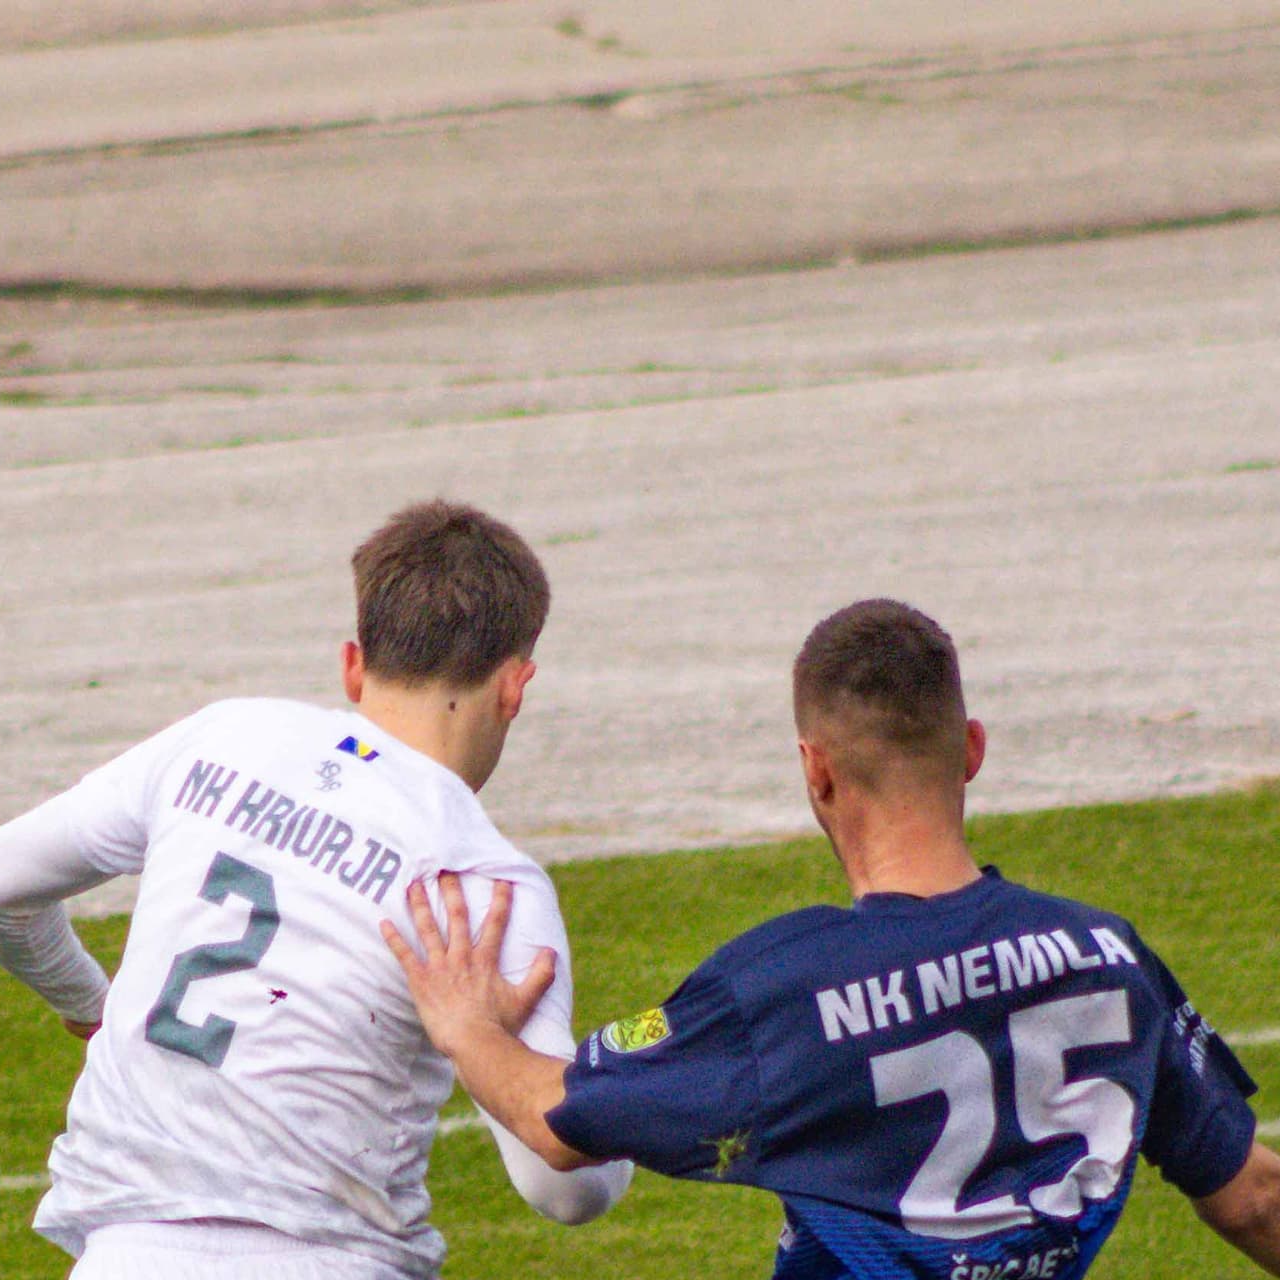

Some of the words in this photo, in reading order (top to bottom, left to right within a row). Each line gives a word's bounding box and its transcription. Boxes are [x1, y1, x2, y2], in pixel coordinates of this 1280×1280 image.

[173, 760, 239, 818] NK
[145, 851, 280, 1068] 2
[816, 970, 912, 1041] NK
[916, 927, 1138, 1014] NEMILA
[869, 989, 1135, 1239] 25
